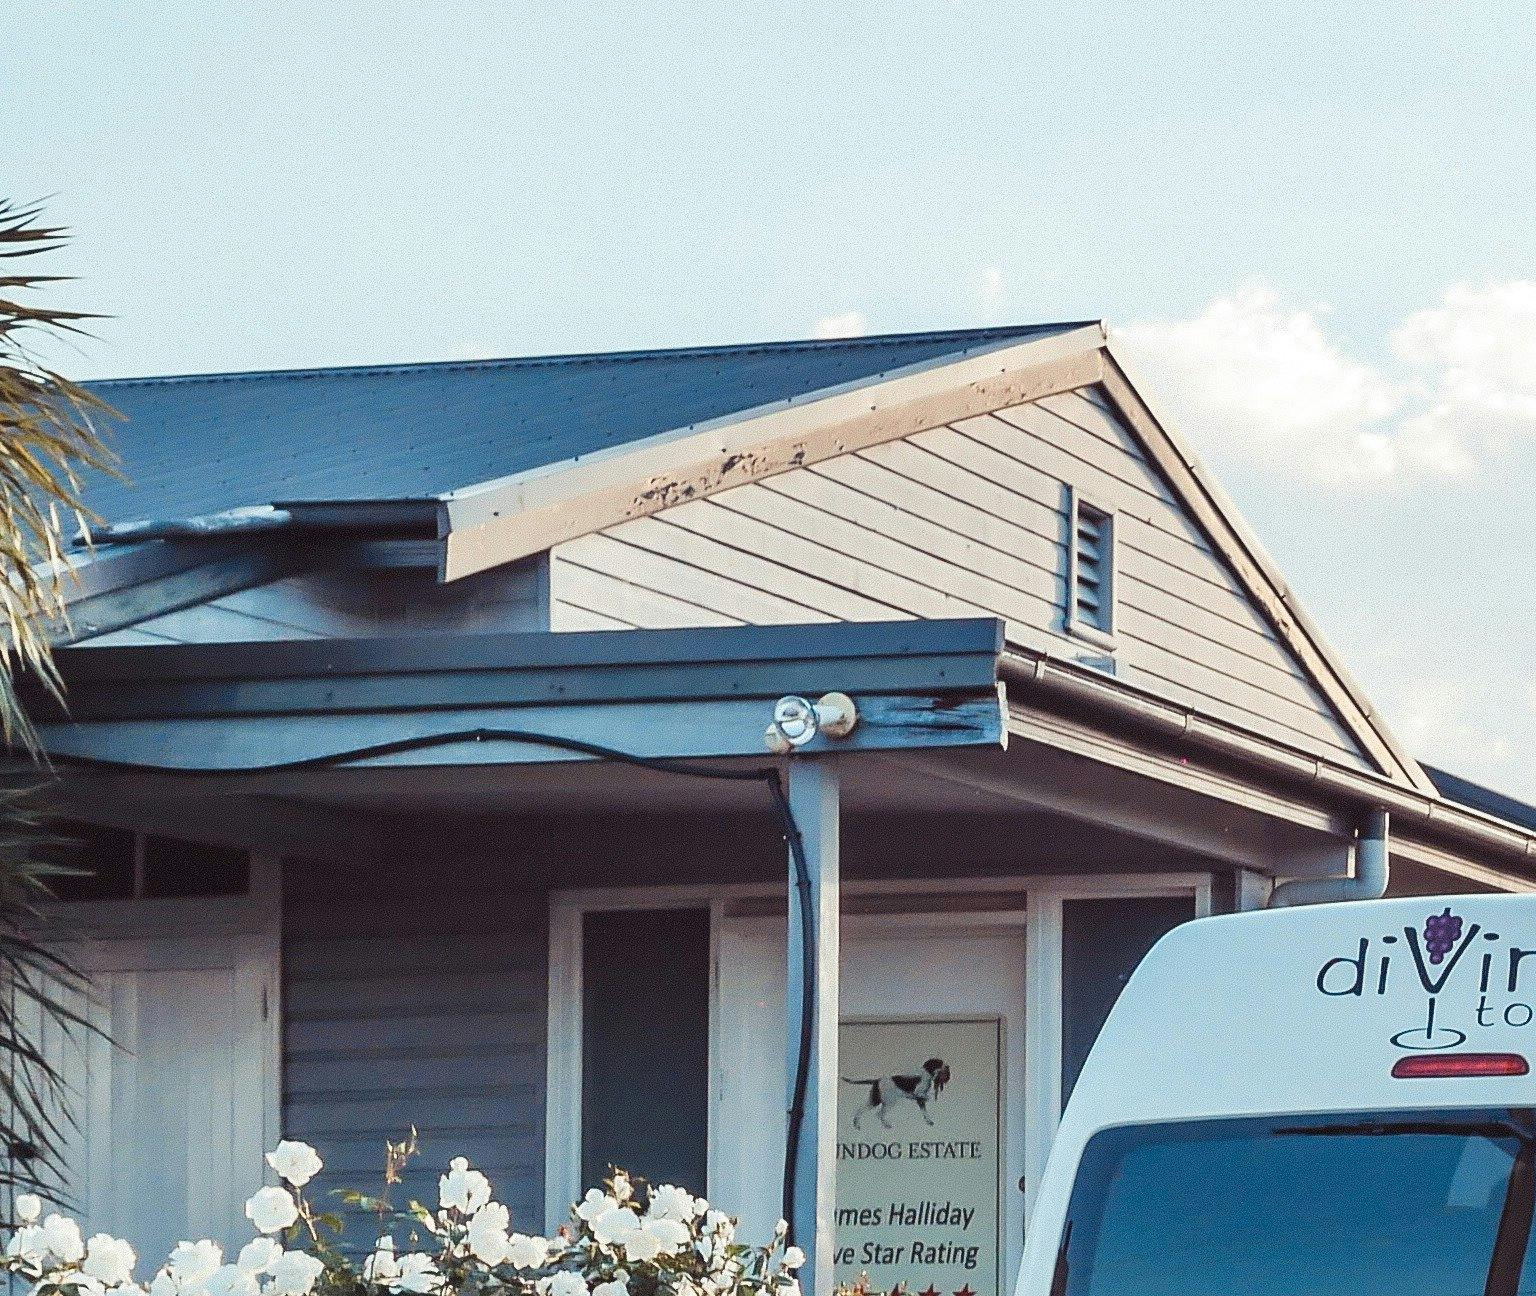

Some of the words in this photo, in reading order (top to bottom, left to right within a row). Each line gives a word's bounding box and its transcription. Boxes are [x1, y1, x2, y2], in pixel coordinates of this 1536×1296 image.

[908, 1141, 981, 1159] ESTATE
[888, 1200, 975, 1231] Halliday
[861, 1242, 904, 1264] Star
[910, 1241, 980, 1270] Rating
